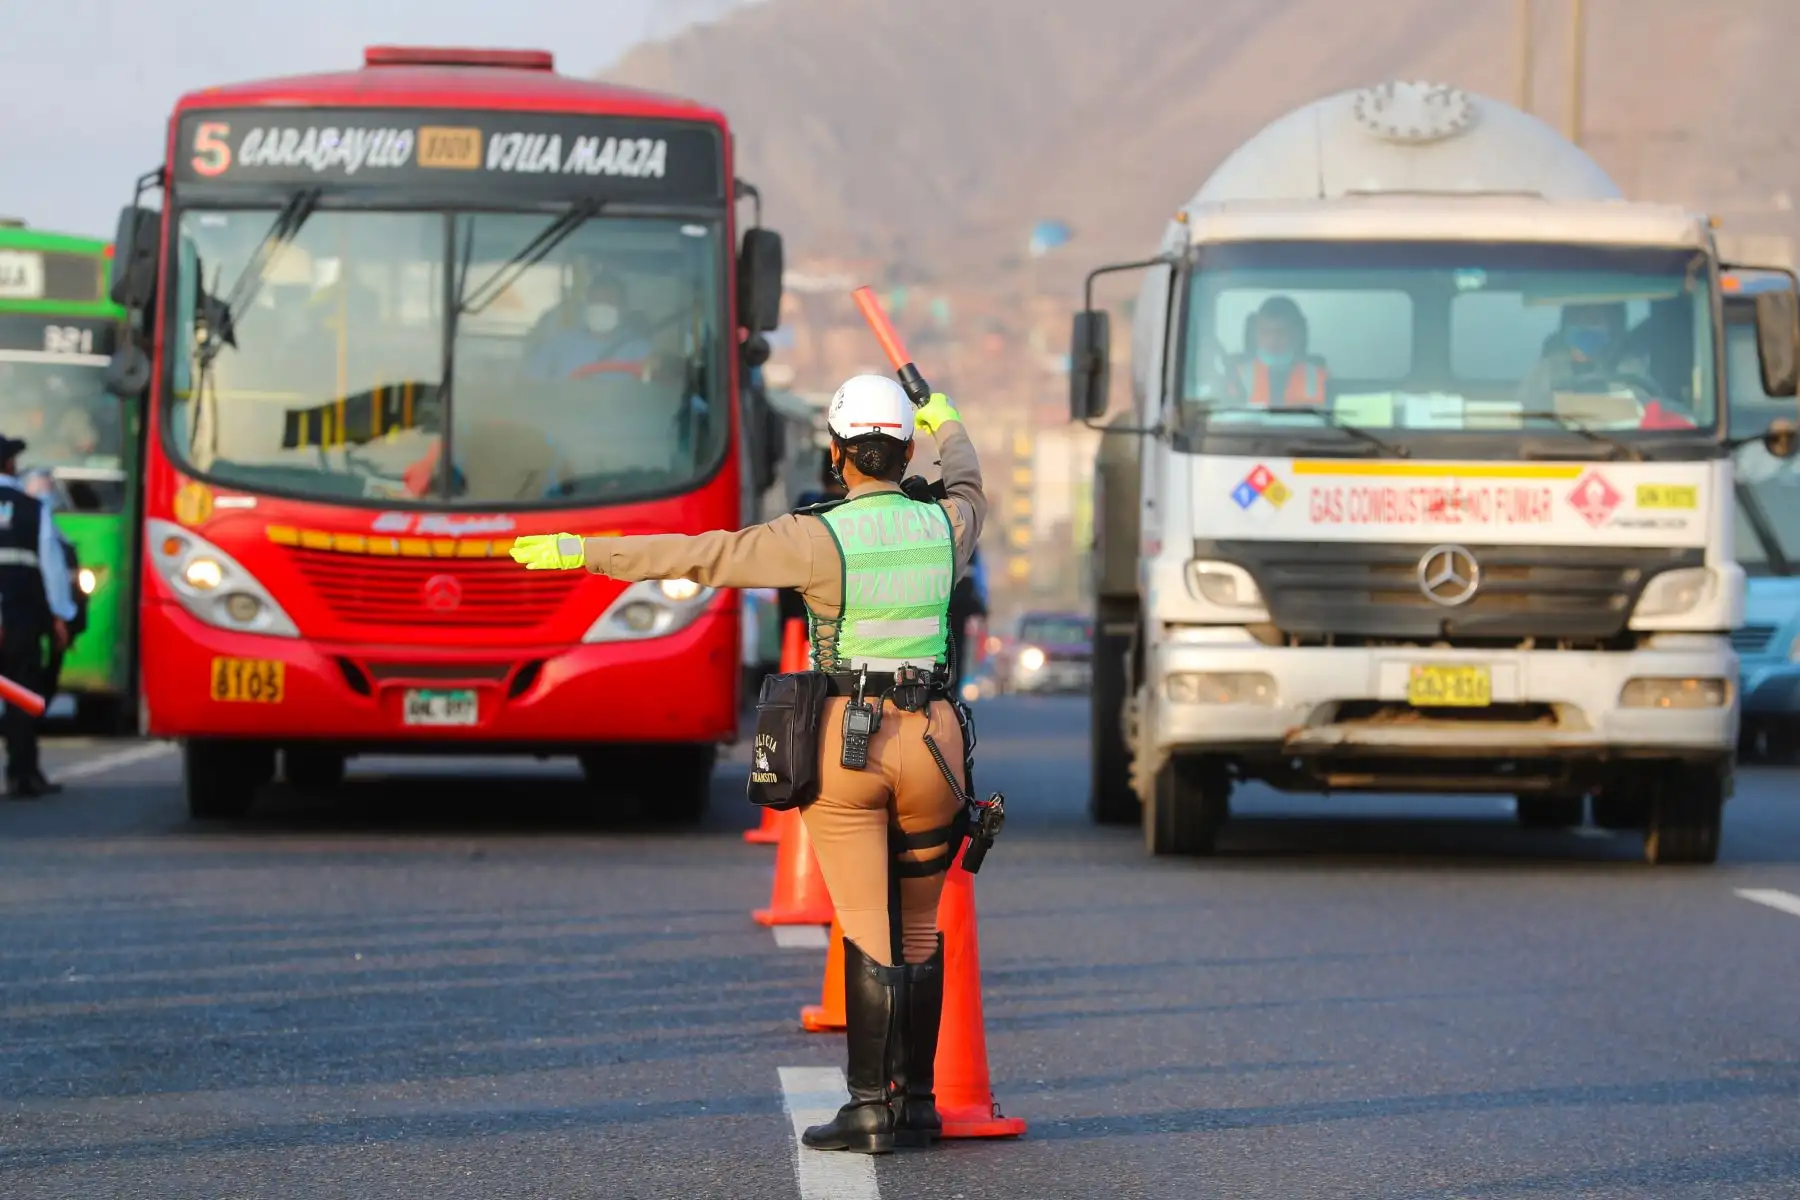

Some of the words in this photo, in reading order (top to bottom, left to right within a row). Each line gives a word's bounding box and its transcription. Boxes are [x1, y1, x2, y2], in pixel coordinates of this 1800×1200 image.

[191, 121, 231, 176] 5
[562, 135, 667, 178] MARIA
[838, 510, 948, 549] POLICIA
[848, 565, 951, 608] TRANSITO
[754, 733, 778, 753] OLICIA
[752, 771, 778, 783] TRANSITO
